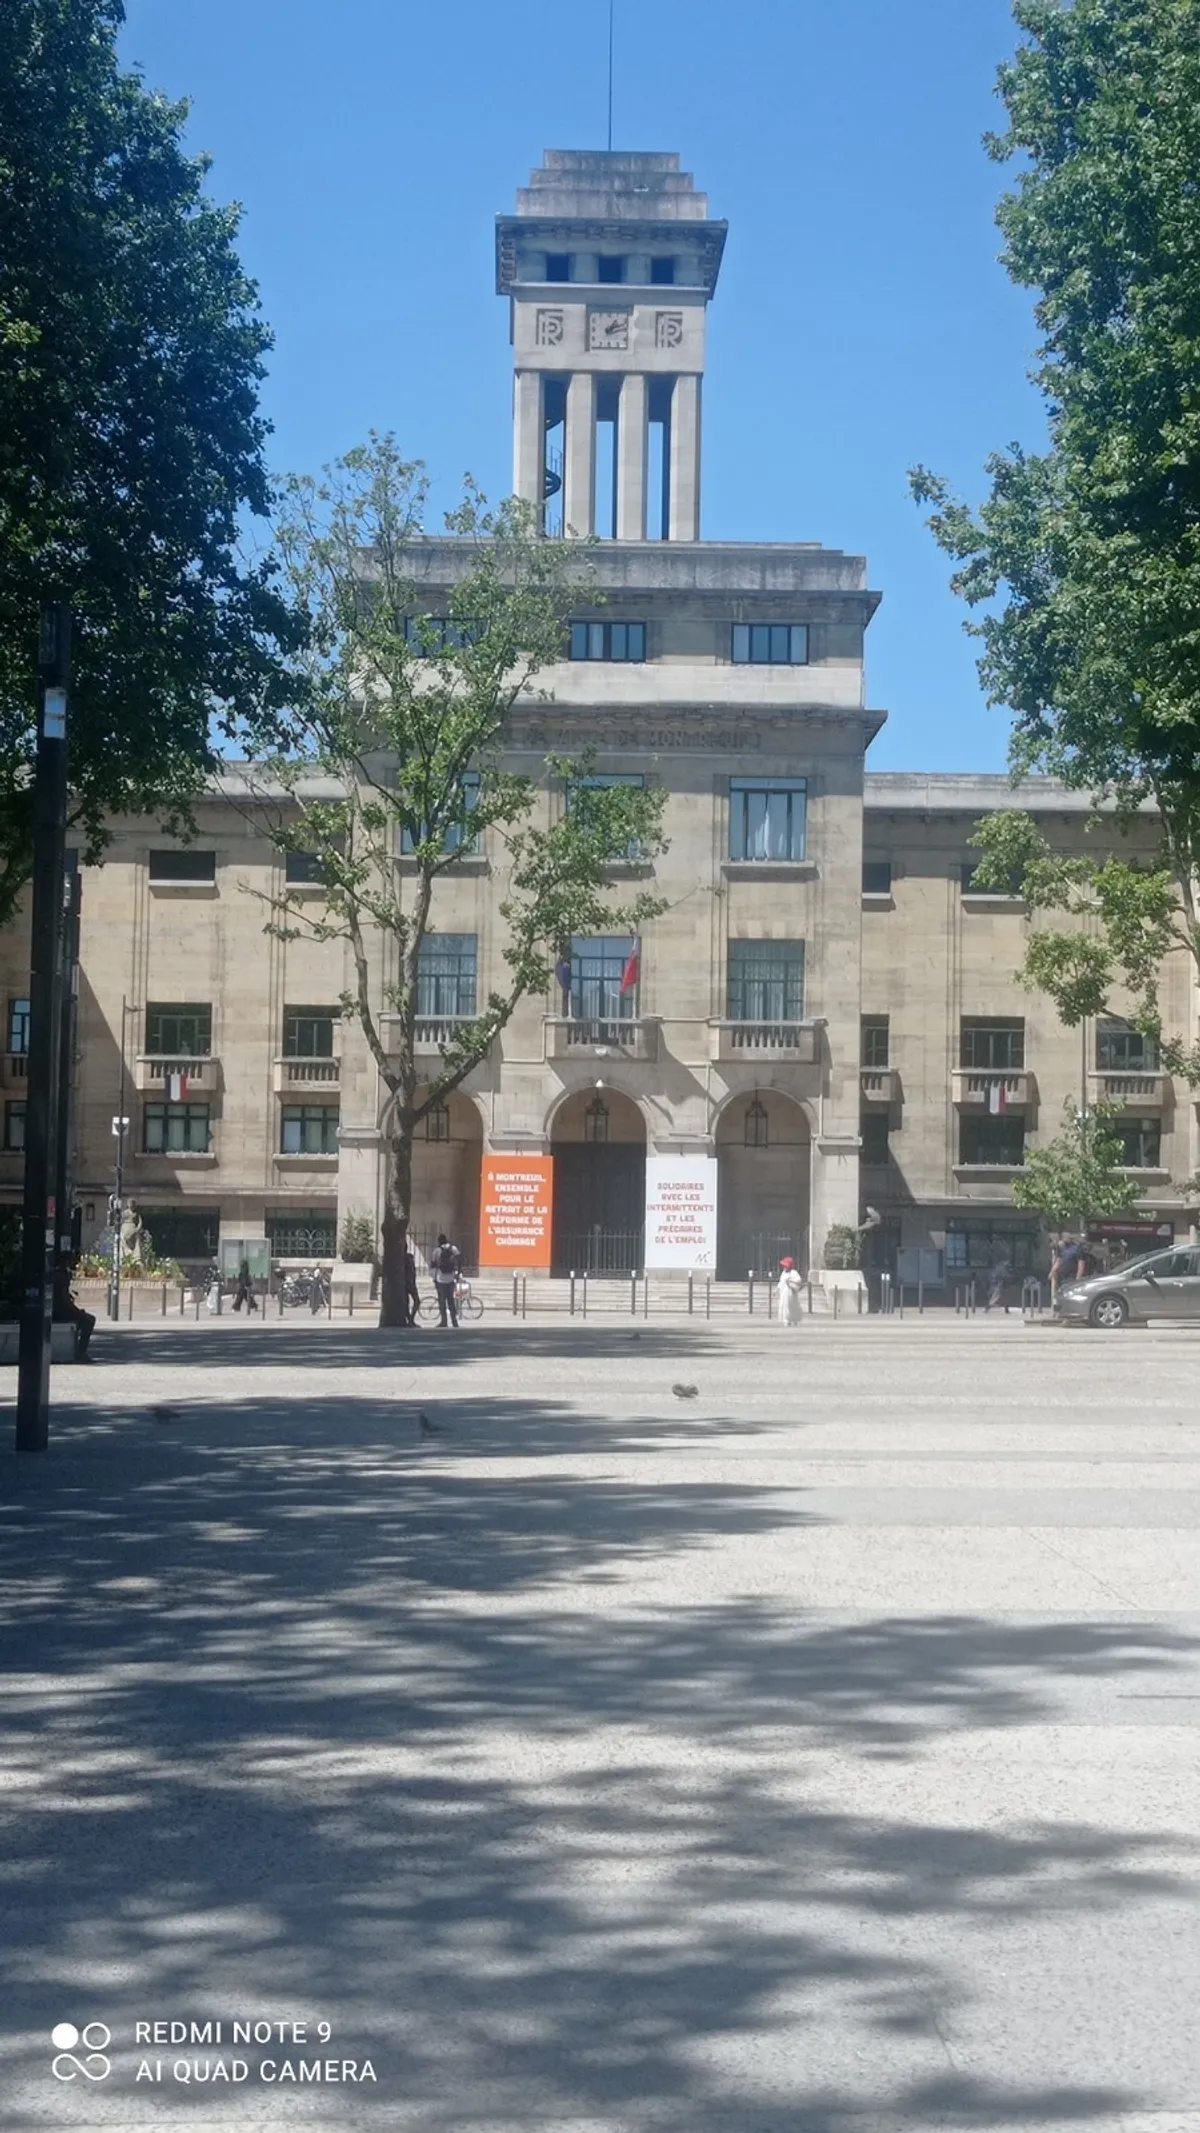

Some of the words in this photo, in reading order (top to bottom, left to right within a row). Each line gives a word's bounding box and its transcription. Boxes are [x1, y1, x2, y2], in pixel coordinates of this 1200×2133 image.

[496, 1173, 546, 1183] MONTREUIL,
[495, 1184, 540, 1192] ENSEMBLE
[499, 1195, 521, 1203] POUR
[524, 1195, 534, 1203] LE
[485, 1205, 521, 1213] RETRAIT
[489, 1215, 529, 1224] RÉFORME
[488, 1227, 544, 1235] L'ASSURANCE
[658, 1224, 703, 1233] PRÉCAIRES
[496, 1236, 536, 1246] CHÔMAGE
